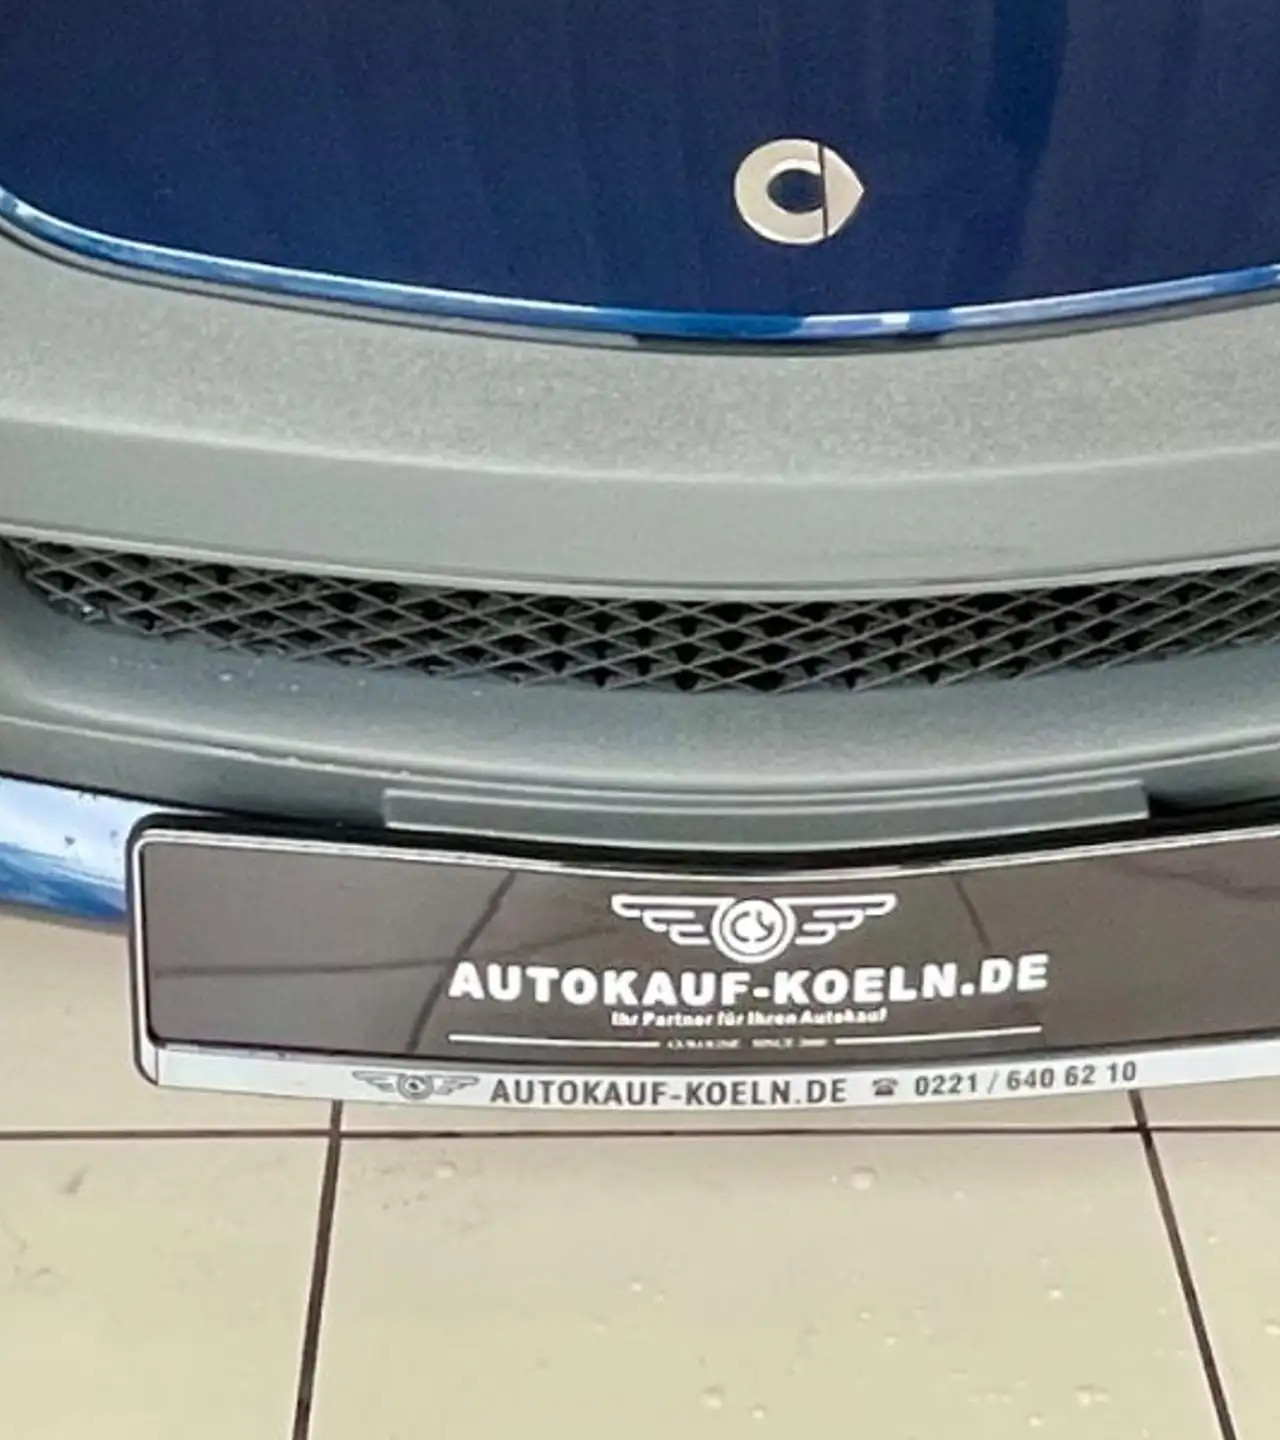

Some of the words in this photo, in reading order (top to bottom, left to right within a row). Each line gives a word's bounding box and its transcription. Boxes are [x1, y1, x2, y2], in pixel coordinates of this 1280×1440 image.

[448, 953, 1049, 1006] AUTOKAUF-KOELN.DE
[611, 1011, 639, 1027] Ihr
[642, 1011, 714, 1027] Partner
[717, 1010, 745, 1027] für
[747, 1010, 797, 1027] Ihren
[799, 1006, 889, 1025] Autokauf
[489, 1078, 848, 1106] AUTOKAUF-KOELN.DE
[915, 1072, 978, 1097] 0221
[1006, 1066, 1055, 1091] 640
[1064, 1063, 1097, 1087] 62
[1107, 1060, 1138, 1084] 10
